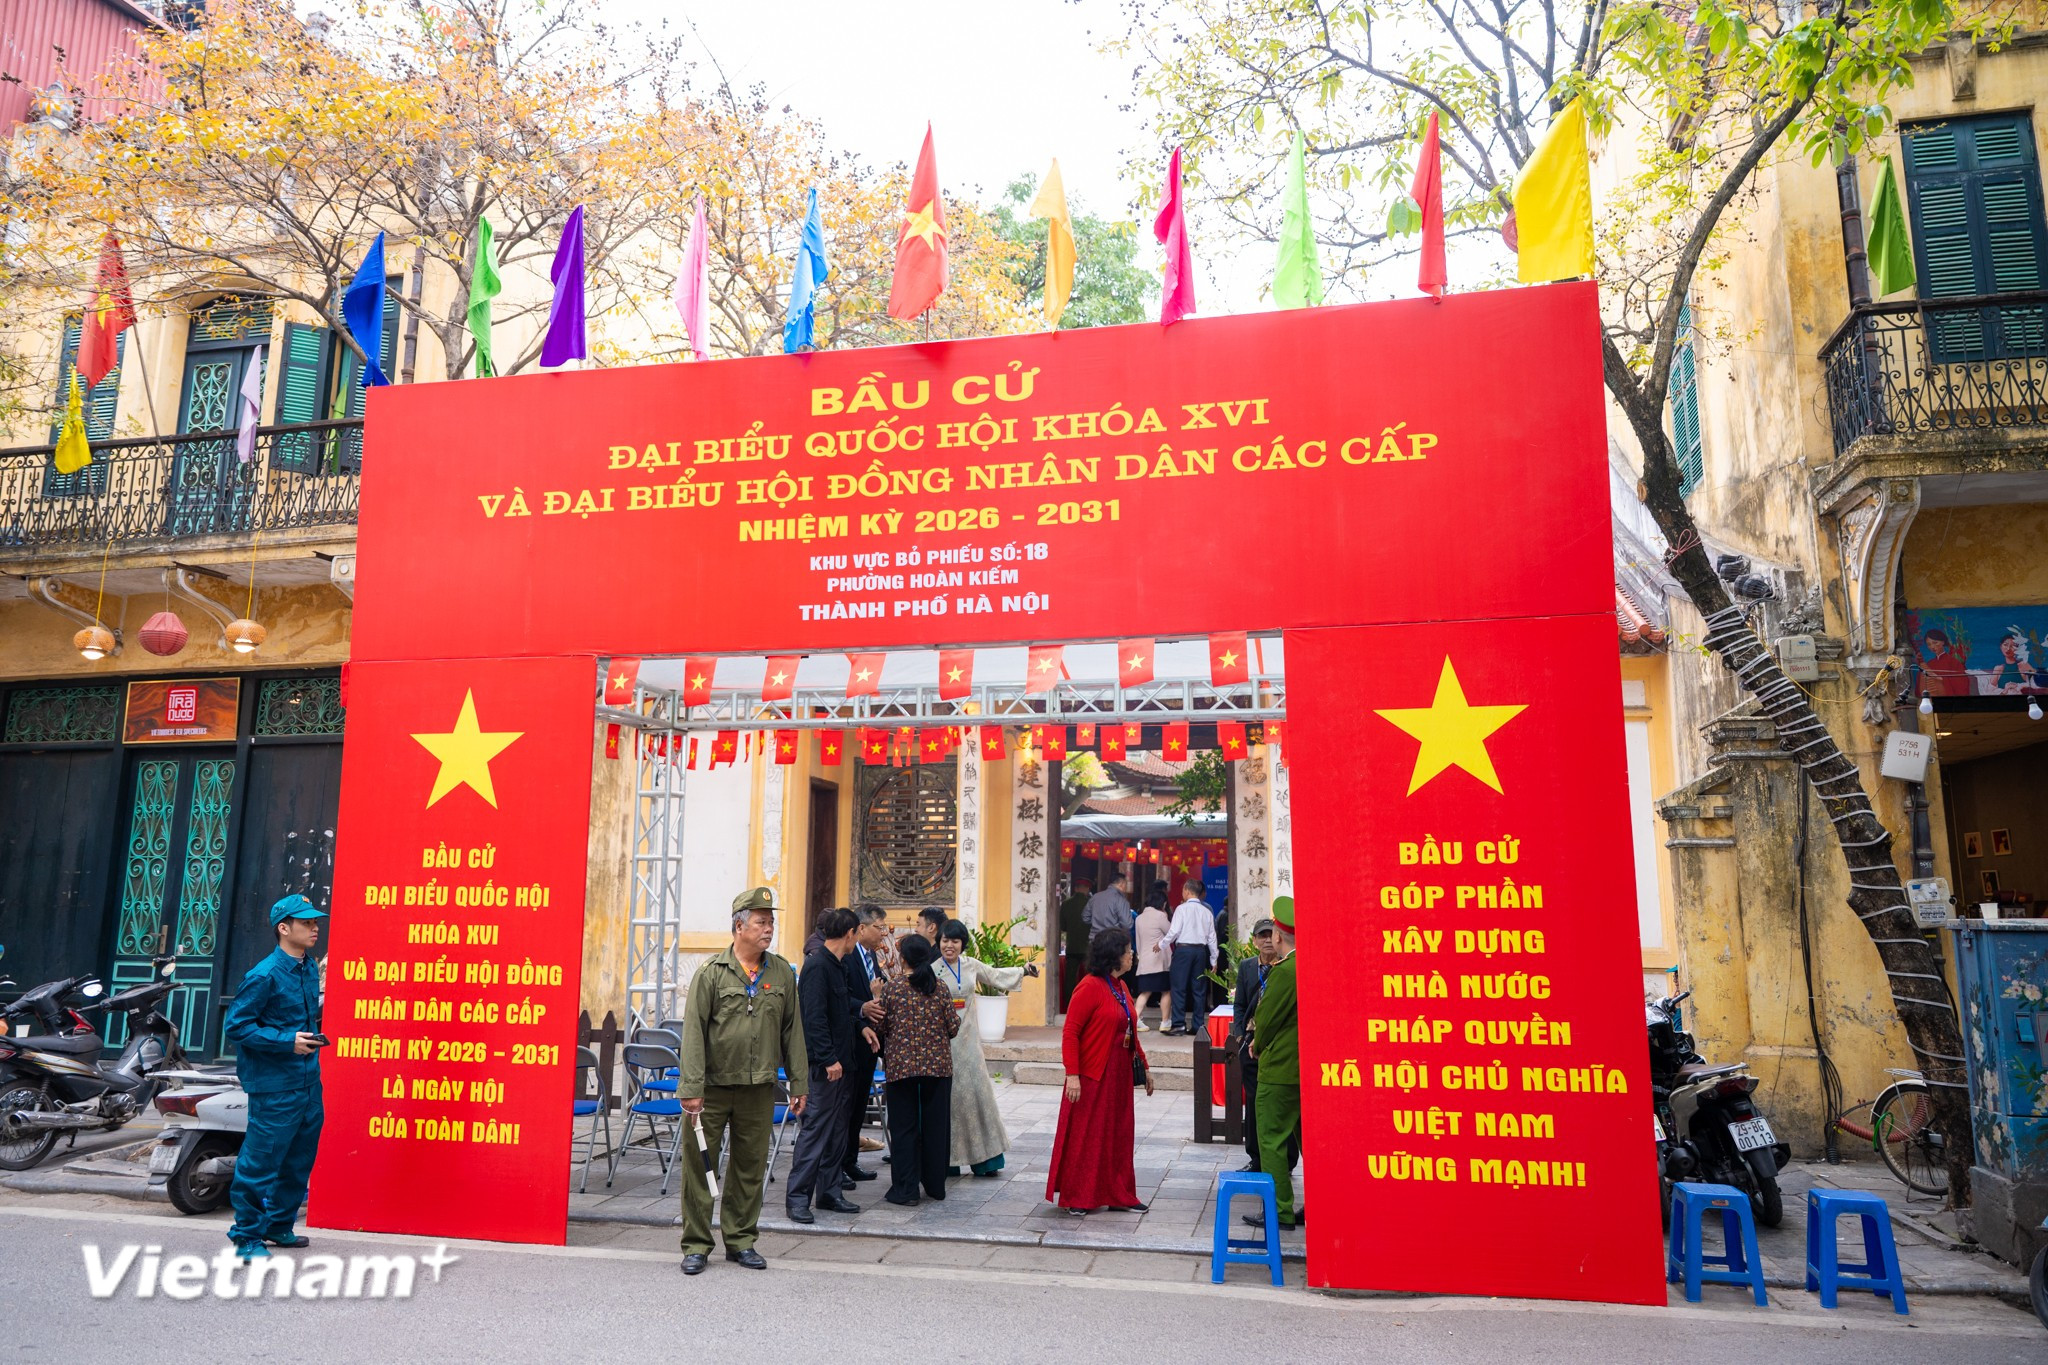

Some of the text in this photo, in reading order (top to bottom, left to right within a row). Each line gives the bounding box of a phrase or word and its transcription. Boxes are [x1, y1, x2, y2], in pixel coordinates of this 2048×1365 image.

[812, 360, 1040, 416] BẦU CỬ
[608, 399, 1269, 473] ĐẠI BIỂU QUỐC HỘI KHÓA XVI
[478, 422, 1438, 519] VÀ ĐẠI BIỂU HỘI ĐỒNG NHÂN DÂN CÁC CẤP
[739, 513, 848, 543] NHIỆM
[861, 508, 904, 535] KỲ
[915, 507, 999, 532] 2026
[1037, 499, 1119, 525] 2031
[810, 555, 847, 570] KHU
[853, 552, 889, 570] VỰC
[896, 546, 920, 566] BỎ
[927, 544, 983, 564] PHIẾU
[827, 565, 1018, 592] PHƯỜNG HOÀN KIẾM
[799, 592, 1049, 620] THÀNH PHỐ HÀ NỘI
[1899, 740, 1919, 749] P756
[423, 841, 496, 868] BẦU CỬ
[1399, 834, 1520, 864] BẦU CỬ
[365, 878, 549, 911] ĐẠI BIỂU QUỐC HỘI
[1381, 877, 1542, 908] GÓP PHẦN
[408, 921, 498, 945] KHÓA XVI
[1383, 926, 1544, 958] XÂY DỰNG
[344, 954, 562, 988] VÀ ĐẠI BIỂU HỘI ĐỒNG
[1383, 971, 1550, 999] NHÀ NƯỚC
[355, 996, 546, 1024] NHÂN DÂN CÁC CẤP
[1368, 1013, 1571, 1045] PHÁP QUYỀN
[337, 1034, 400, 1062] NHIỆM
[408, 1036, 432, 1060] KỲ
[438, 1041, 486, 1062] 2026
[512, 1044, 558, 1065] 2031
[383, 1075, 504, 1107] LÀ NGÀY HỘI
[1321, 1059, 1627, 1093] XÃ HỘI CHỦ NGHĨA
[369, 1112, 520, 1144] CỦA TOÀN DÂN!
[1393, 1107, 1554, 1139] VIỆT NAM
[1735, 1120, 1765, 1136] 29-BG
[1738, 1131, 1774, 1150] 001.13
[1368, 1151, 1585, 1189] VỮNG MẠNH!
